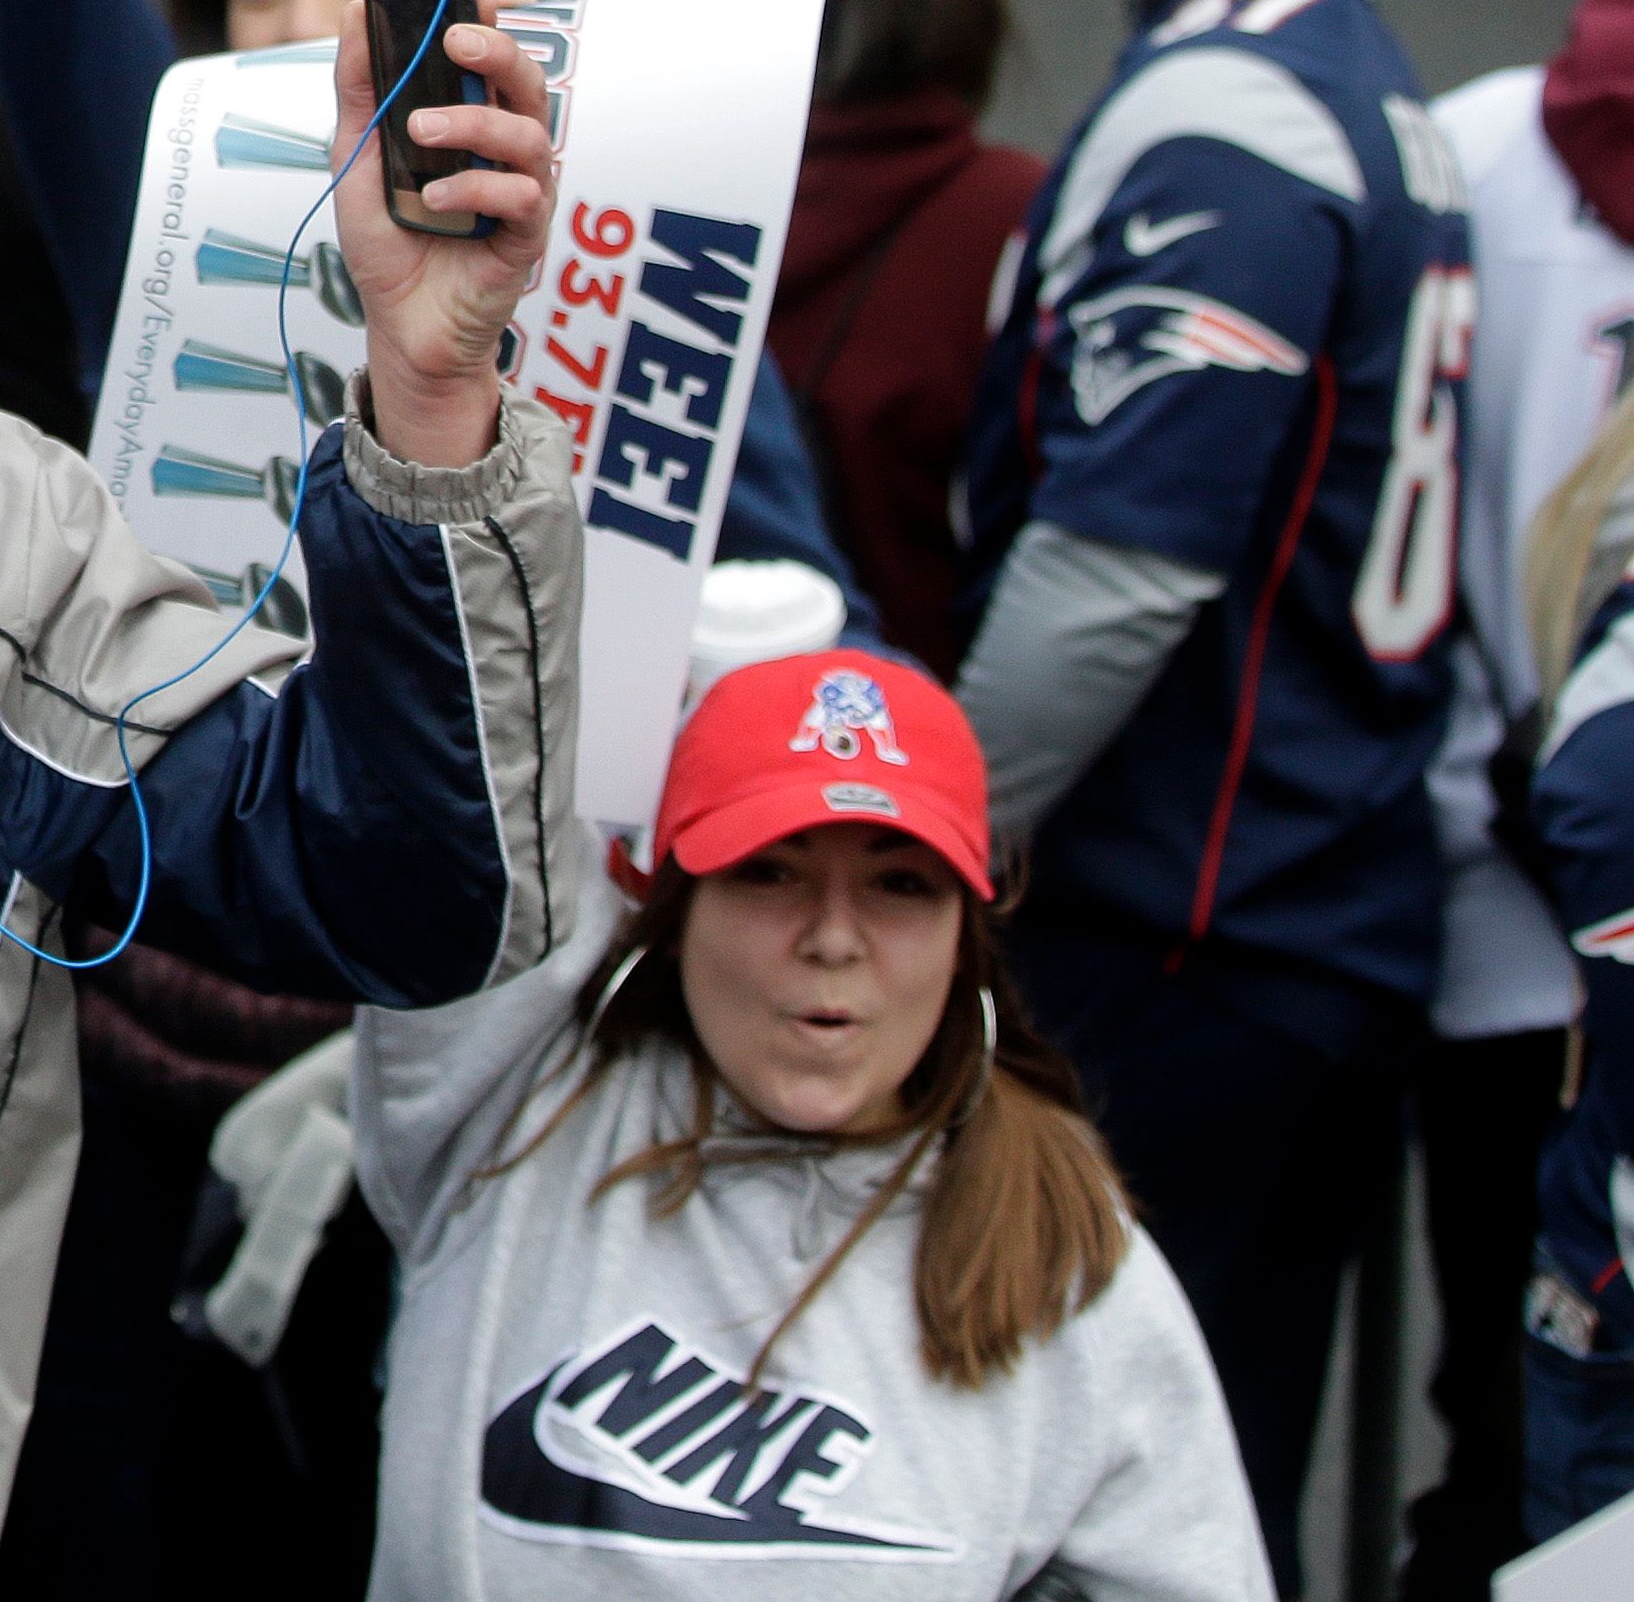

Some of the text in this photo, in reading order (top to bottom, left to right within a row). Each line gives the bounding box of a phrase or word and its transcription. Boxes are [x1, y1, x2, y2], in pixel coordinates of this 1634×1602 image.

[108, 77, 206, 522] massgeneral.org/EverydayAma
[535, 201, 635, 476] 93.7F
[588, 207, 765, 564] WEEI
[554, 1322, 872, 1518] NIKE
